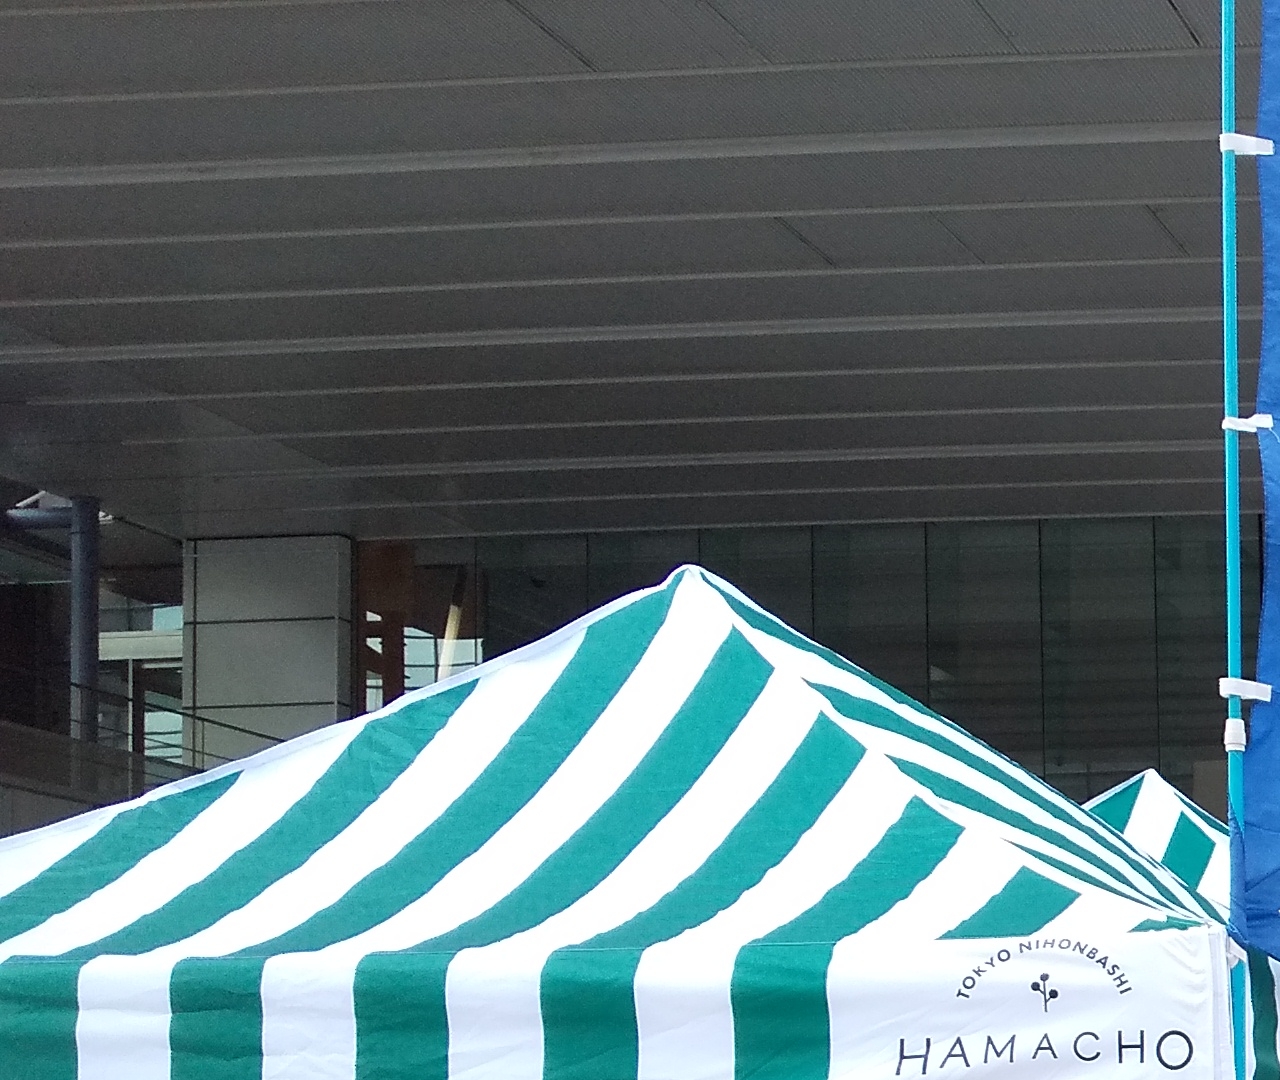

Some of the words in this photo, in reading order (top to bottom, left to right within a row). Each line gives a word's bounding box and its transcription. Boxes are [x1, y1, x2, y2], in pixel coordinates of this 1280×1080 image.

[956, 948, 1012, 1000] TOKYO
[1018, 938, 1133, 995] NIHONBASHI
[895, 1029, 1194, 1075] HAMACHO
